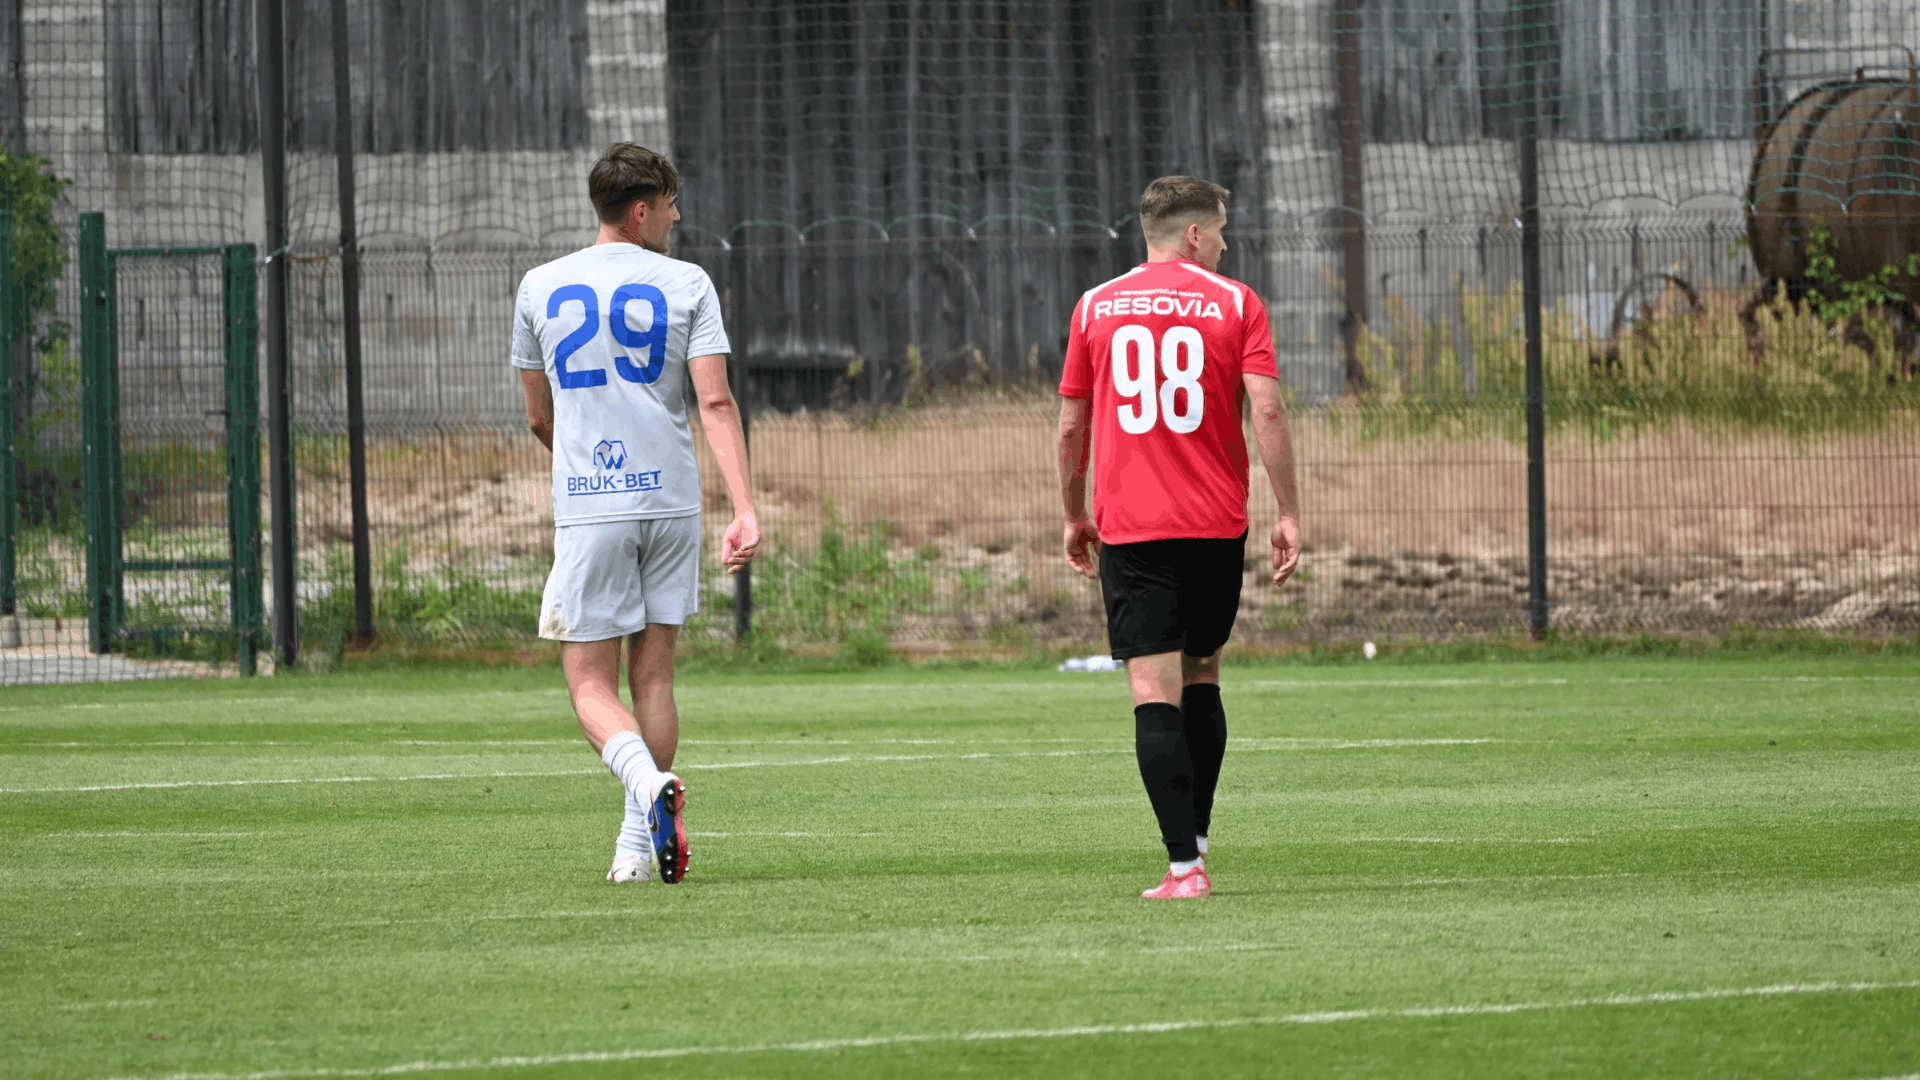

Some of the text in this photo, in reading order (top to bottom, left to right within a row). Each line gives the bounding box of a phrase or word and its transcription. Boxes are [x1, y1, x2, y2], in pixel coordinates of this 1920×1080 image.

[547, 283, 668, 389] 29
[1095, 296, 1223, 320] RESOVIA
[1111, 324, 1205, 434] 98
[568, 470, 661, 492] BRUK-BET
